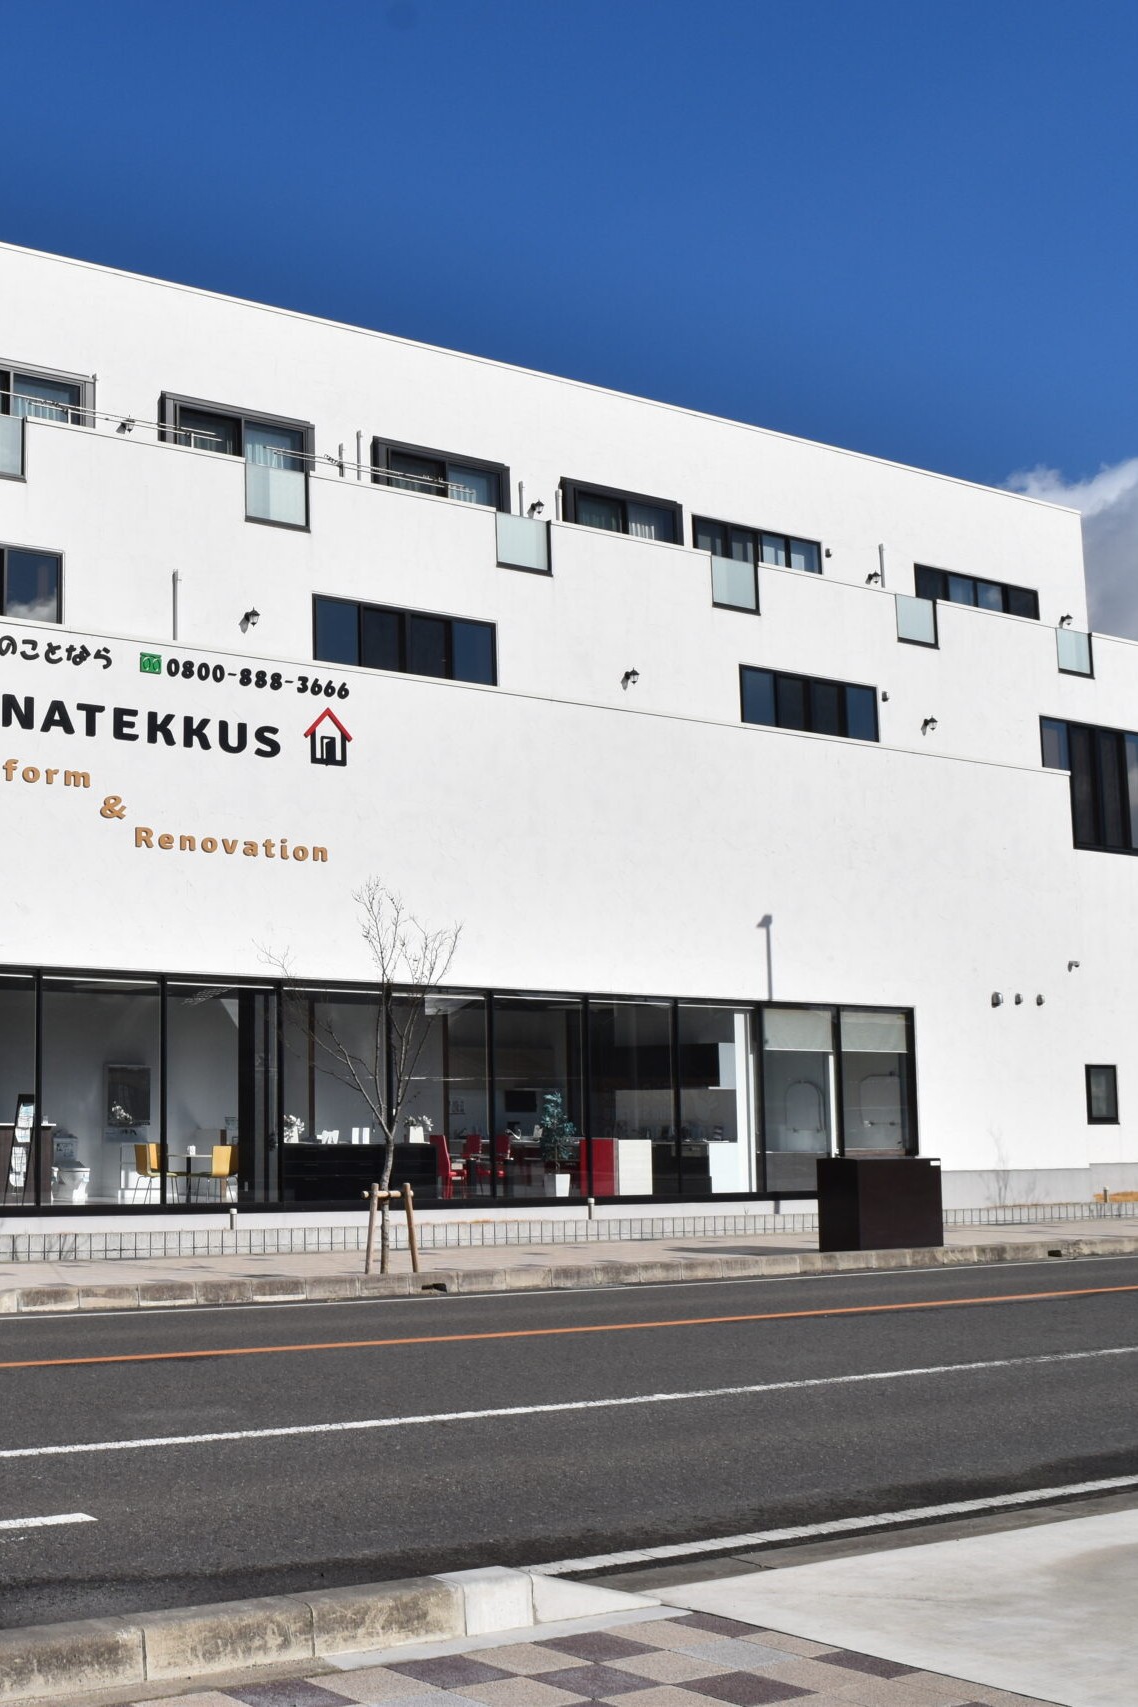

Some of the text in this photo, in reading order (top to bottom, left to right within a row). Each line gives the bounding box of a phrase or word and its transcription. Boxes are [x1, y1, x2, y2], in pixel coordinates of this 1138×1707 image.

[167, 658, 350, 700] 0800-888-3666
[100, 795, 126, 819] &
[135, 826, 329, 863] Renovation
